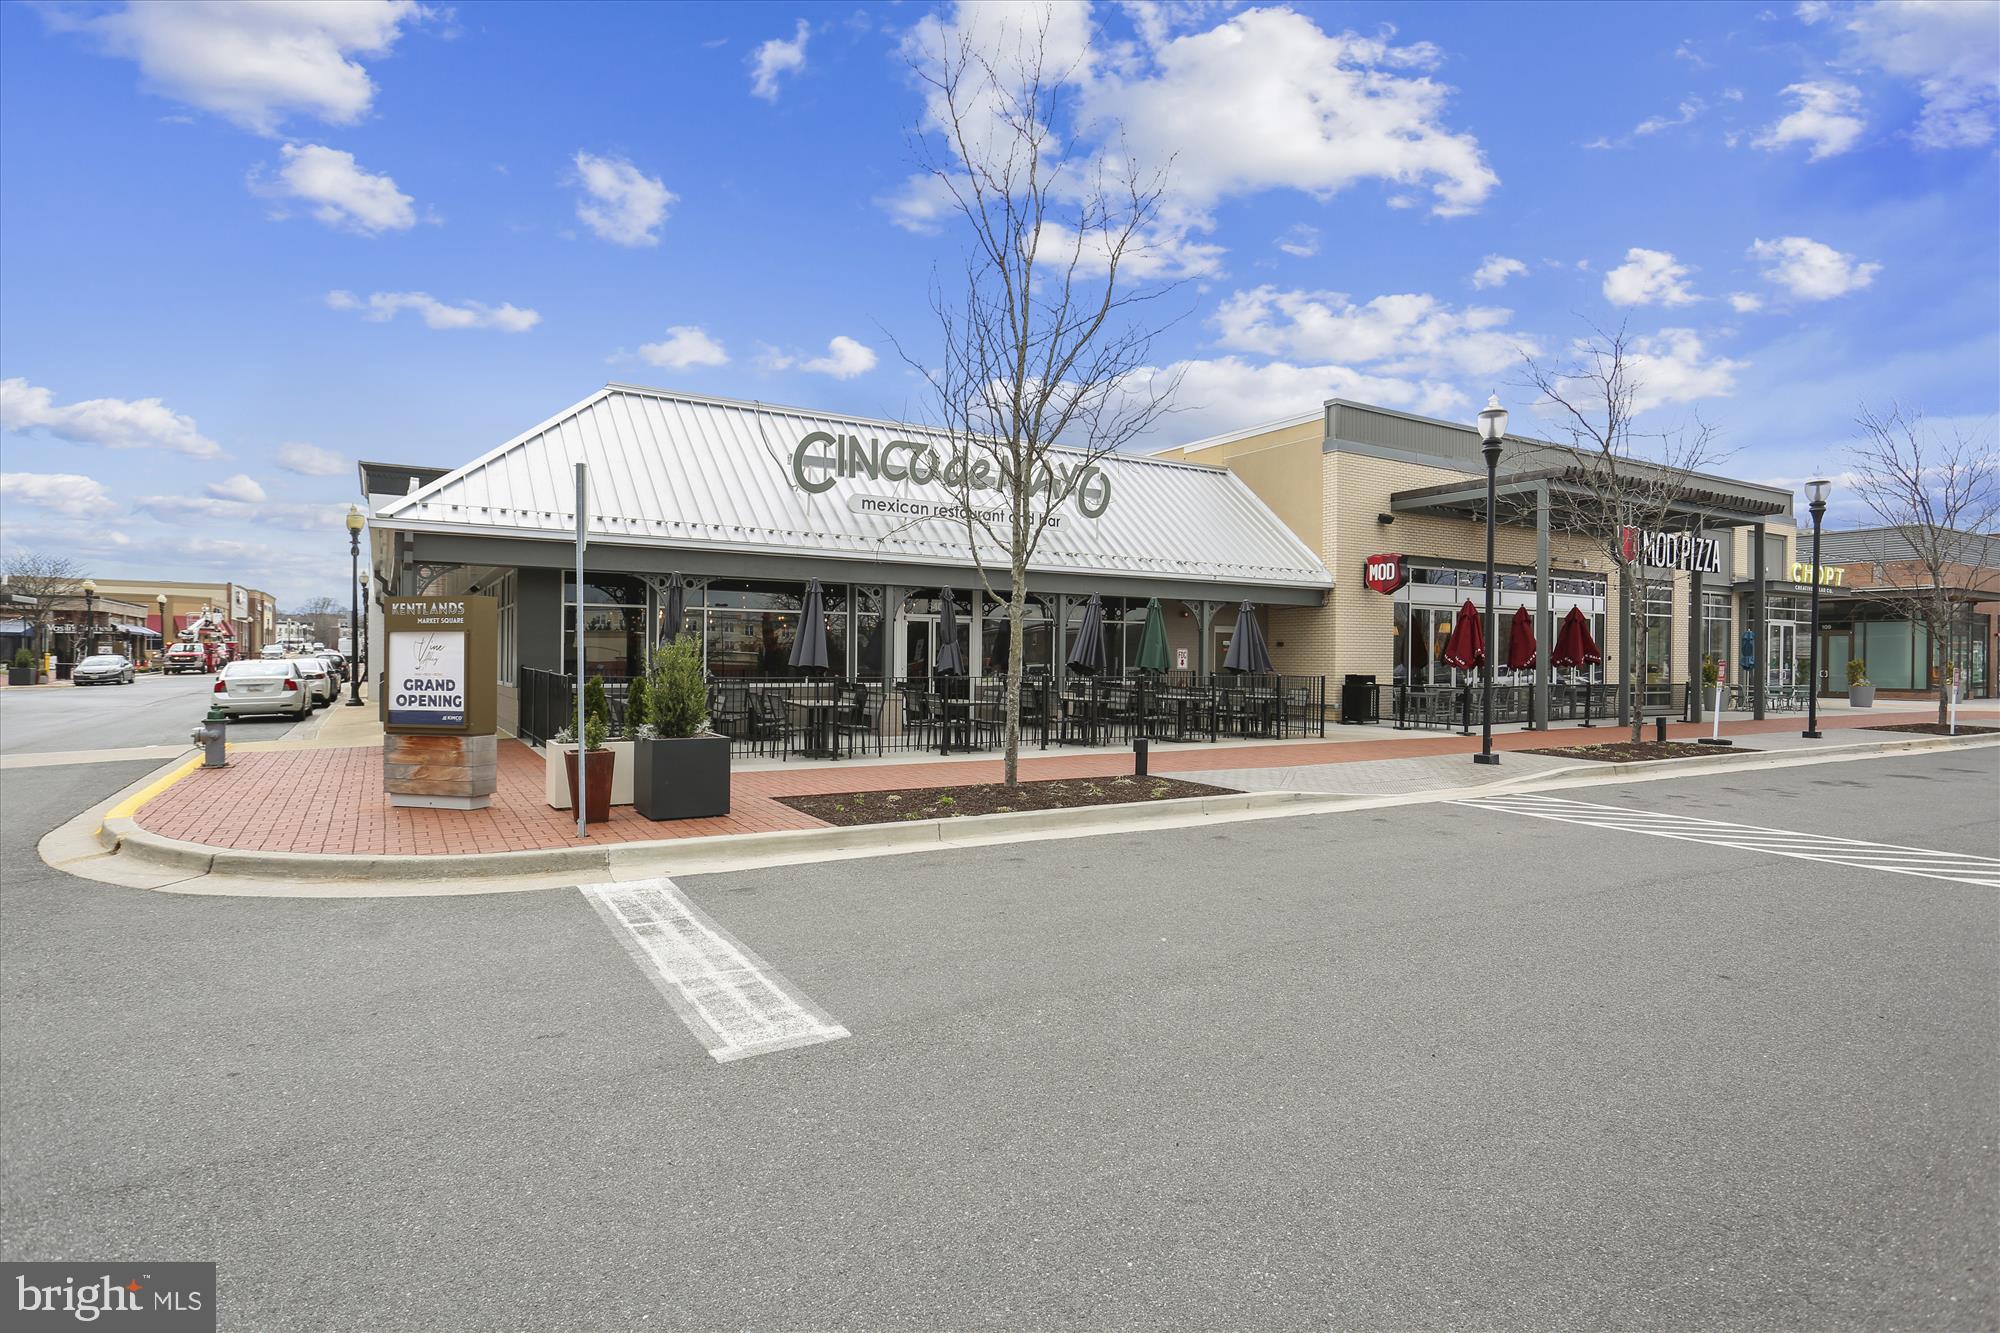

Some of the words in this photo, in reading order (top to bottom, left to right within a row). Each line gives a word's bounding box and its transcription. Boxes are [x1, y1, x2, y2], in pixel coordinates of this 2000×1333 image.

[793, 431, 940, 493] CINCO
[944, 447, 992, 490] de
[861, 498, 929, 516] mexican
[933, 504, 1005, 523] restaurant
[1643, 530, 1677, 568] MOD
[1681, 536, 1721, 573] PIZZA
[1369, 562, 1395, 581] MOD
[391, 602, 465, 615] KENTLANDS
[403, 678, 456, 692] GRAND
[395, 694, 463, 708] OPENING
